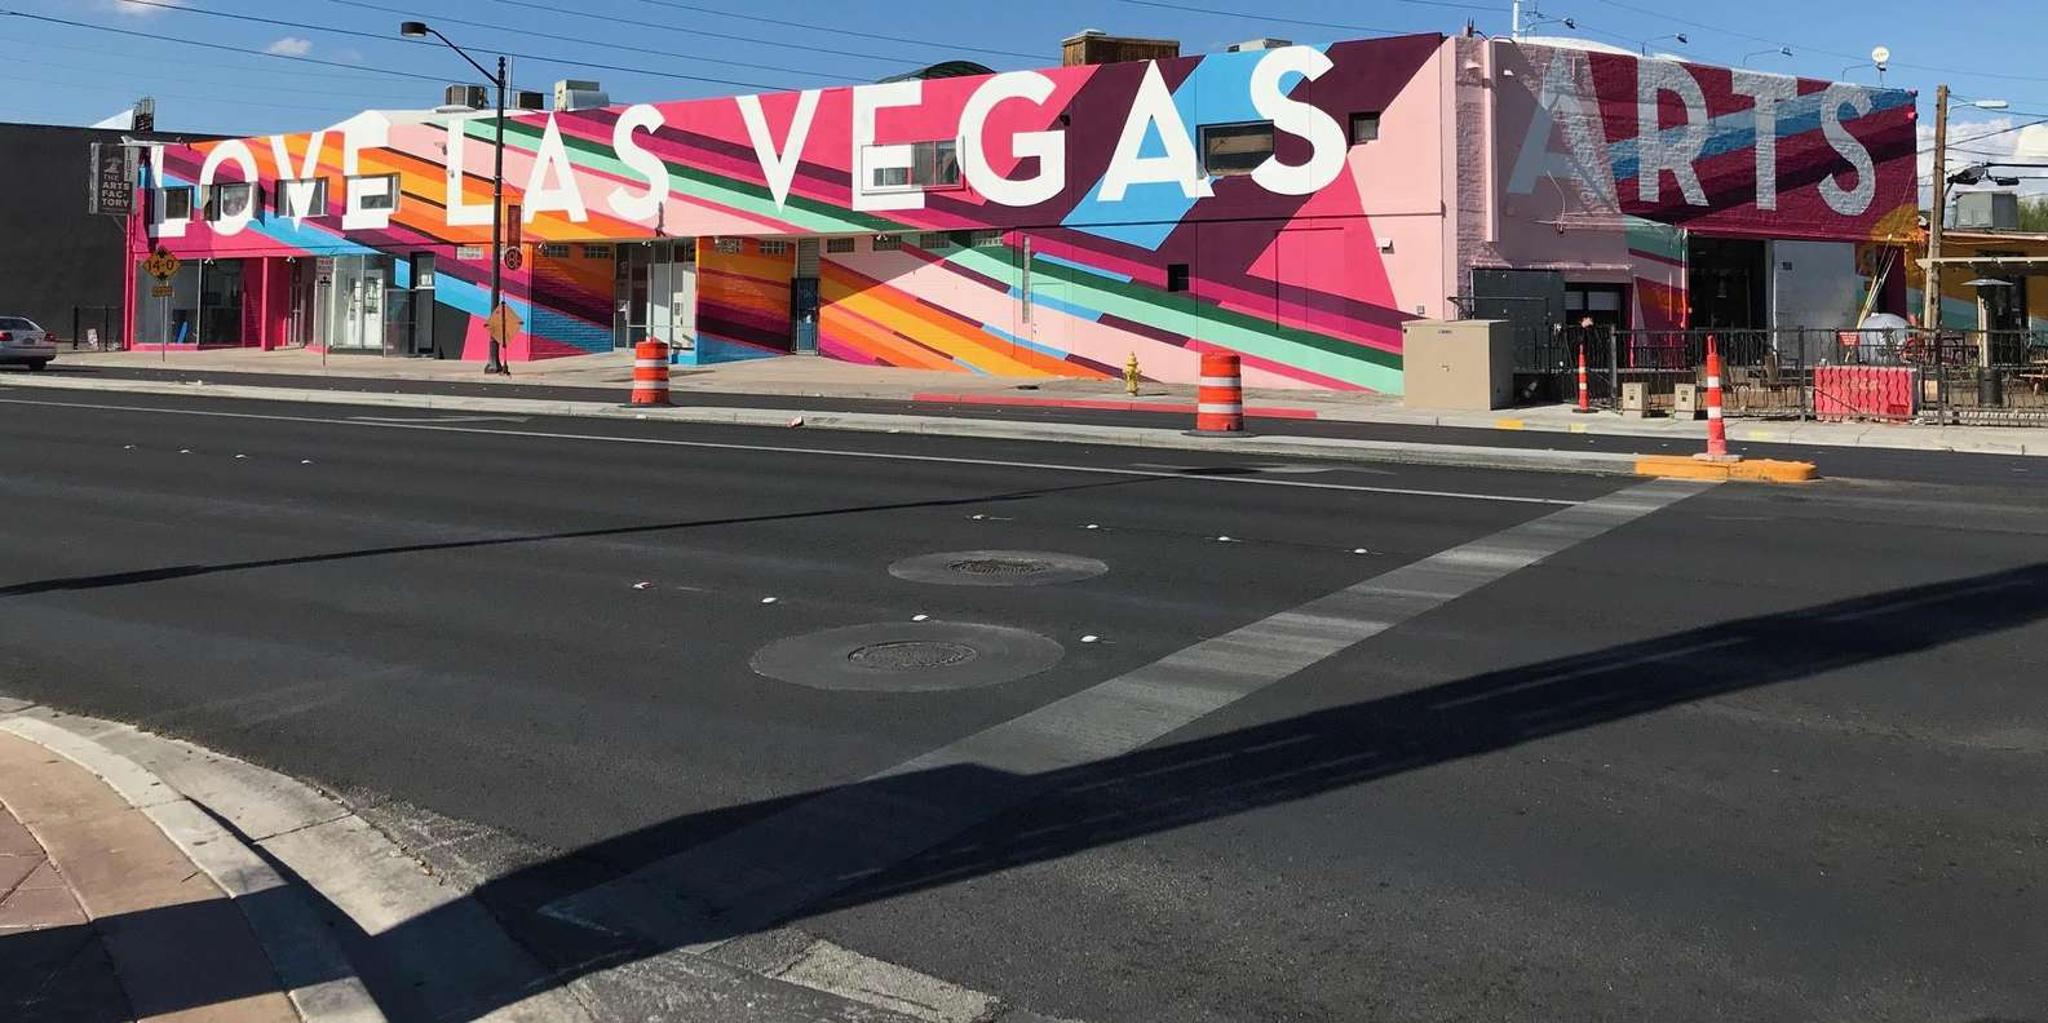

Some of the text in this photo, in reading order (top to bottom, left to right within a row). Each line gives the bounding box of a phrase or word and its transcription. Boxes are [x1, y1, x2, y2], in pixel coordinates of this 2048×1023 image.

[149, 45, 1876, 237] LOVE LAS VEGAS ARTS
[102, 181, 130, 191] ARTS
[101, 190, 127, 199] FAC-
[101, 199, 130, 207] TORY
